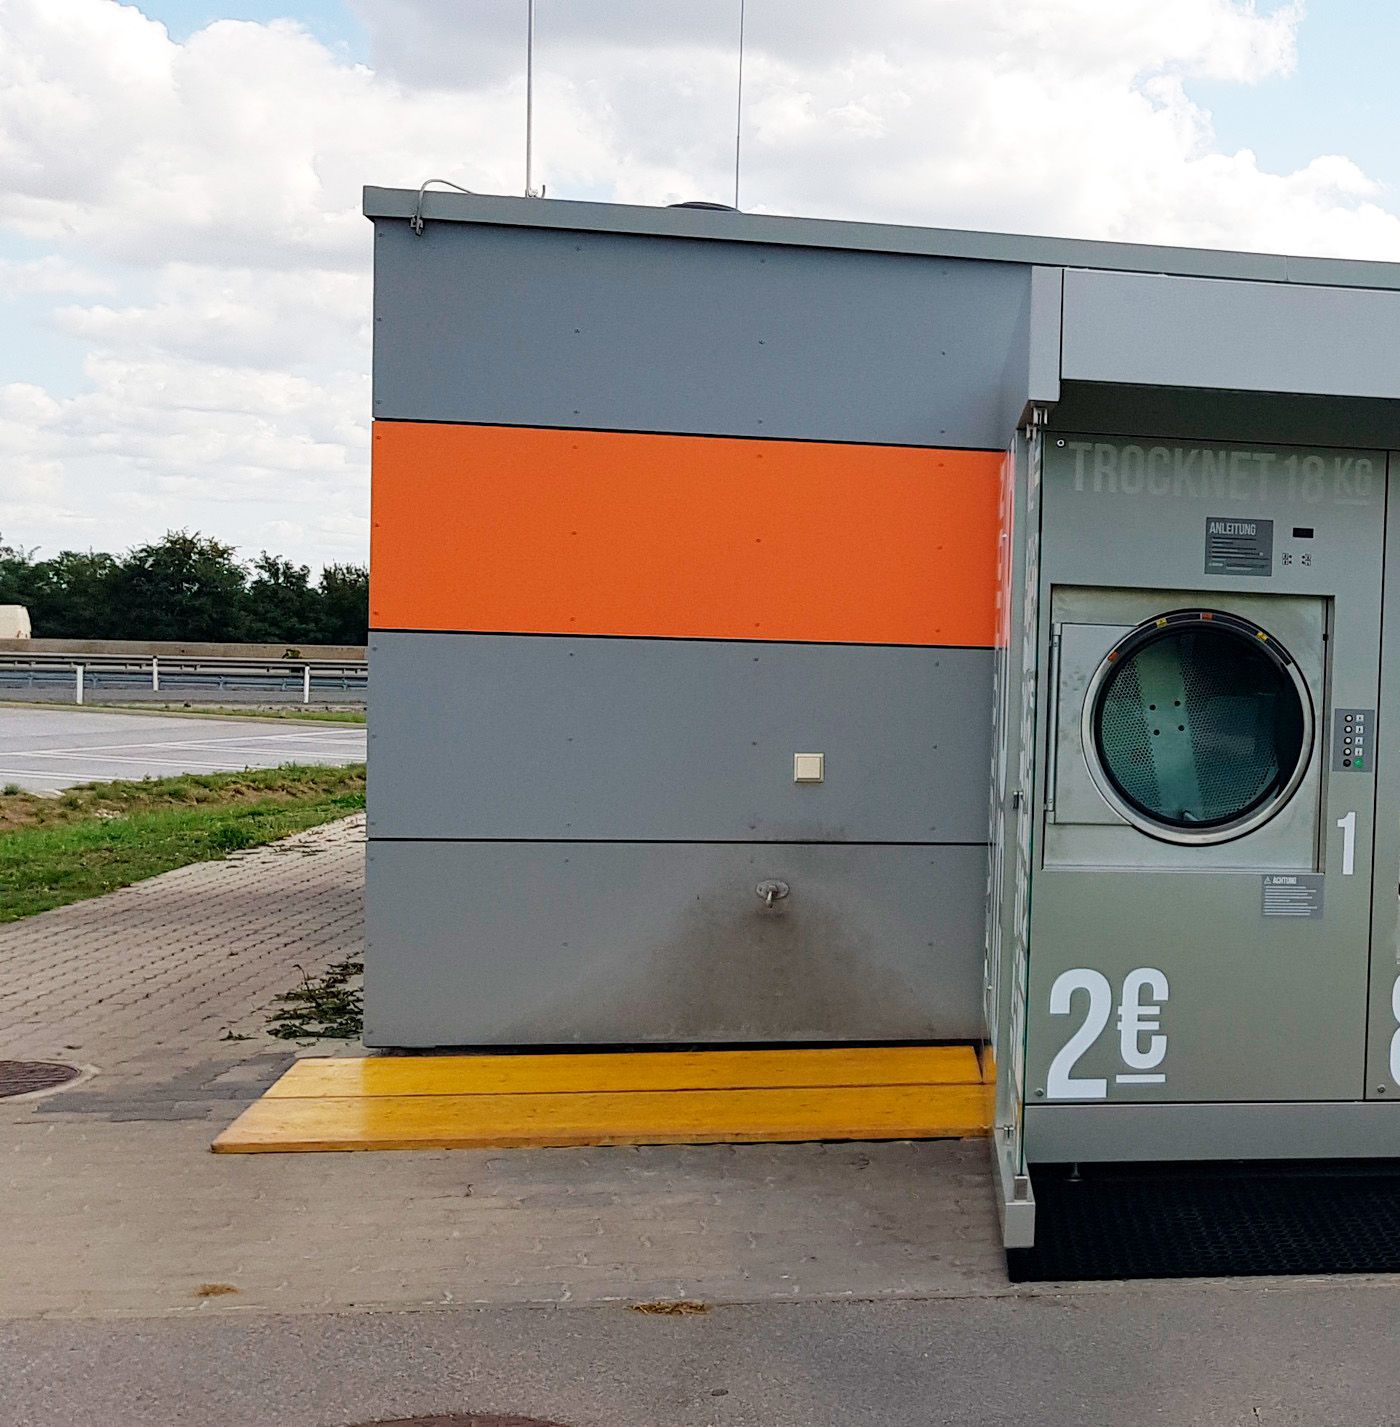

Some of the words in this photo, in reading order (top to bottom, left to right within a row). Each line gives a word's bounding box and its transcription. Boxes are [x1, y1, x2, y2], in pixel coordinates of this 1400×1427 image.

[1068, 441, 1276, 501] TROCKNET
[1284, 455, 1325, 504] 18
[1334, 457, 1373, 497] KG
[1209, 522, 1256, 535] ANLEITUNG
[1337, 812, 1355, 874] 1
